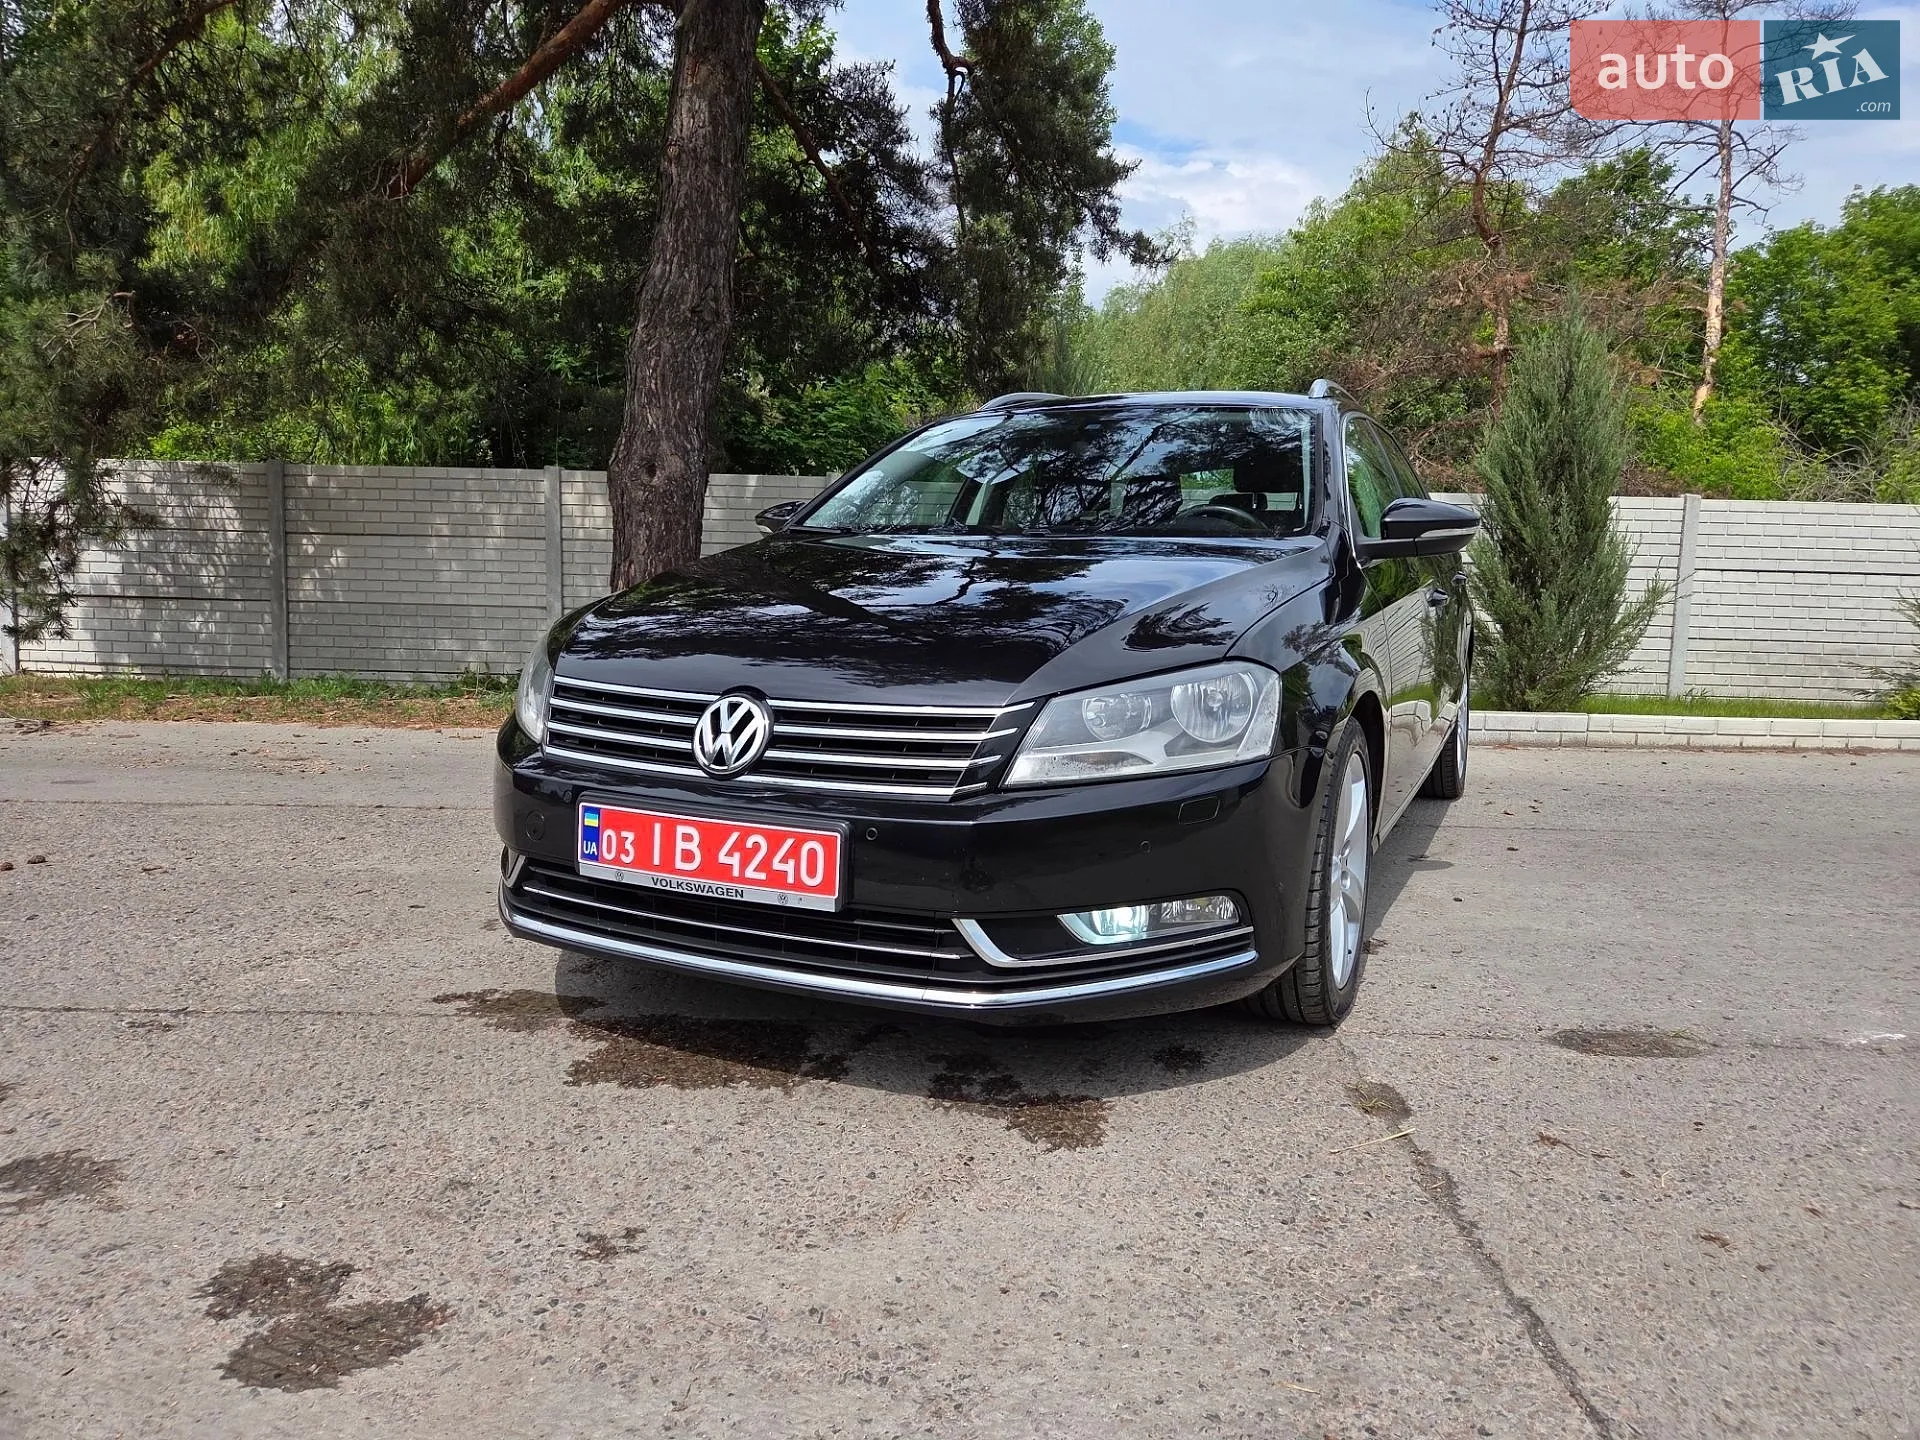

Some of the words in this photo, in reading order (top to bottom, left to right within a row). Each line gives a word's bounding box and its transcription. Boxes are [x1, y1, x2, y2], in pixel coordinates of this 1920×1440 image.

[583, 840, 598, 856] UA
[602, 828, 636, 864] 03
[717, 831, 825, 887] 4240
[651, 877, 744, 899] VOLKSWAGEN
